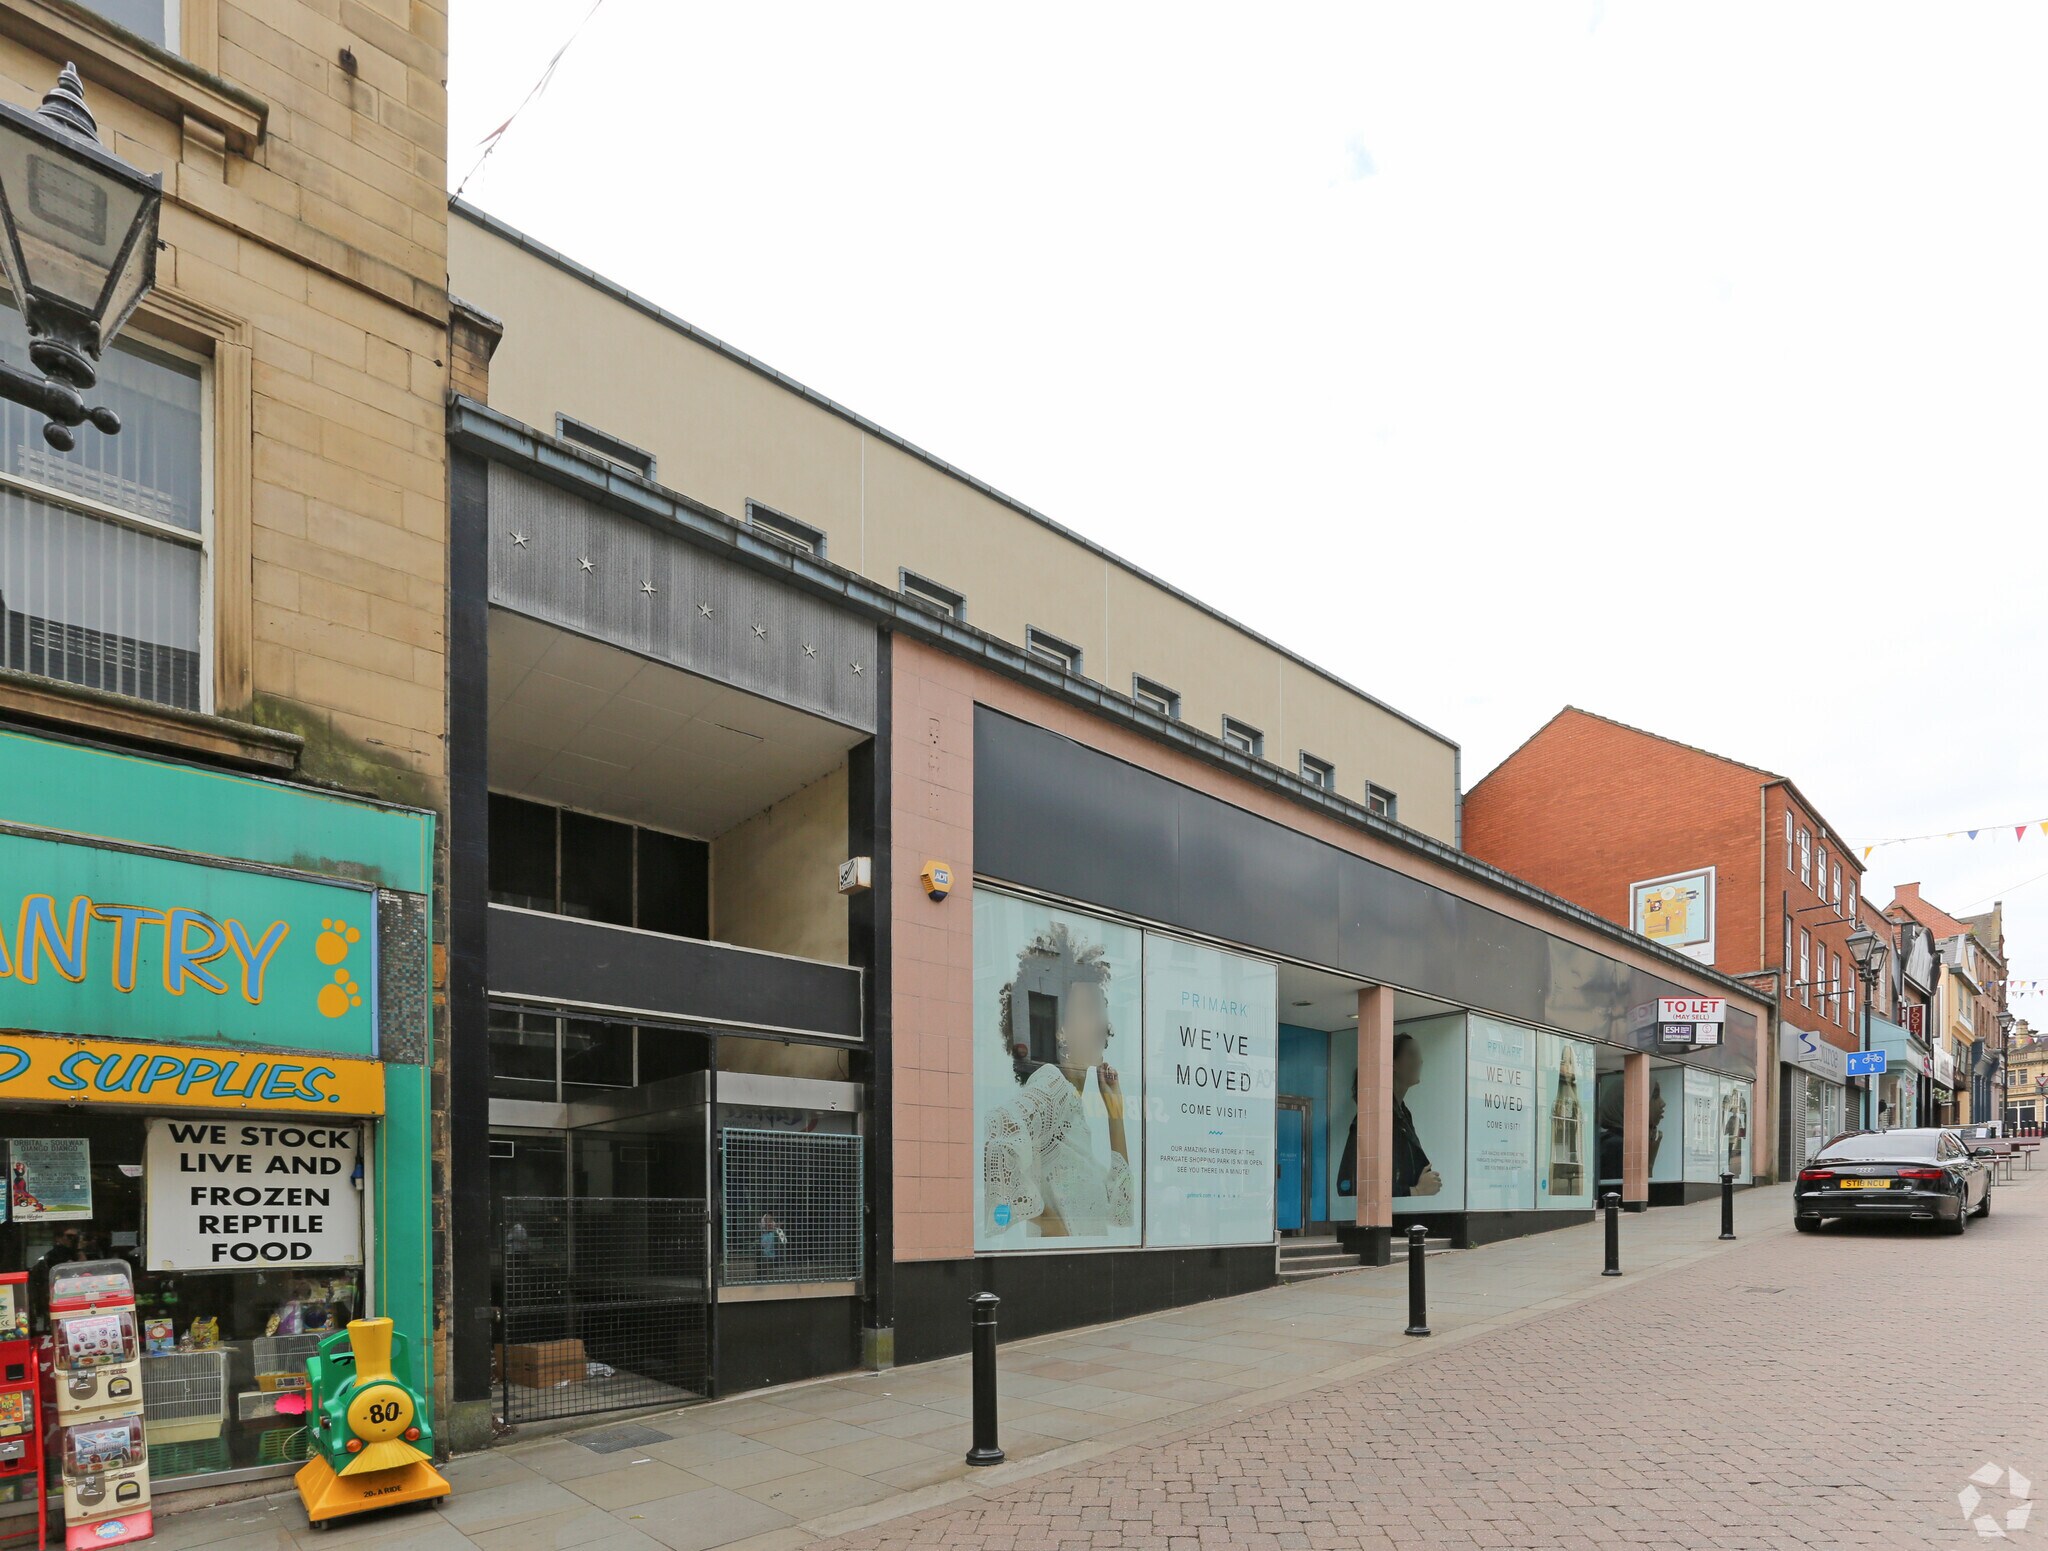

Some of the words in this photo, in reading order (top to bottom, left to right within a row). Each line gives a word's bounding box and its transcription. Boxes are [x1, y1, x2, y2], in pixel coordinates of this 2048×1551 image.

[935, 871, 948, 883] ADT
[1181, 991, 1248, 1018] PRIMARK
[1664, 1001, 1687, 1013] TO
[1692, 1001, 1719, 1013] LET
[1179, 1025, 1249, 1056] WE'VE
[48, 1050, 341, 1103] SUPPLIES.
[1176, 1063, 1251, 1092] MOVED
[1486, 1065, 1521, 1086] WE'VE
[1180, 1103, 1212, 1115] COME
[1216, 1107, 1247, 1119] VISIT!
[1484, 1093, 1523, 1111] MOVED
[1486, 1120, 1503, 1130] COME
[1504, 1122, 1521, 1131] VISIT!
[168, 1124, 227, 1146] WE
[240, 1127, 351, 1150] STOCK
[1160, 1155, 1188, 1163] PARKGATE
[1189, 1156, 1216, 1164] SHOPPING
[1216, 1157, 1230, 1165] PARK
[1184, 1146, 1208, 1154] AMAZING
[180, 1153, 252, 1175] LIVE
[265, 1156, 343, 1176] AND
[191, 1186, 330, 1207] FROZEN
[199, 1215, 323, 1235] REPTILE
[212, 1242, 313, 1263] FOOD
[369, 1402, 400, 1425] 80
[384, 1485, 402, 1494] RIDE
